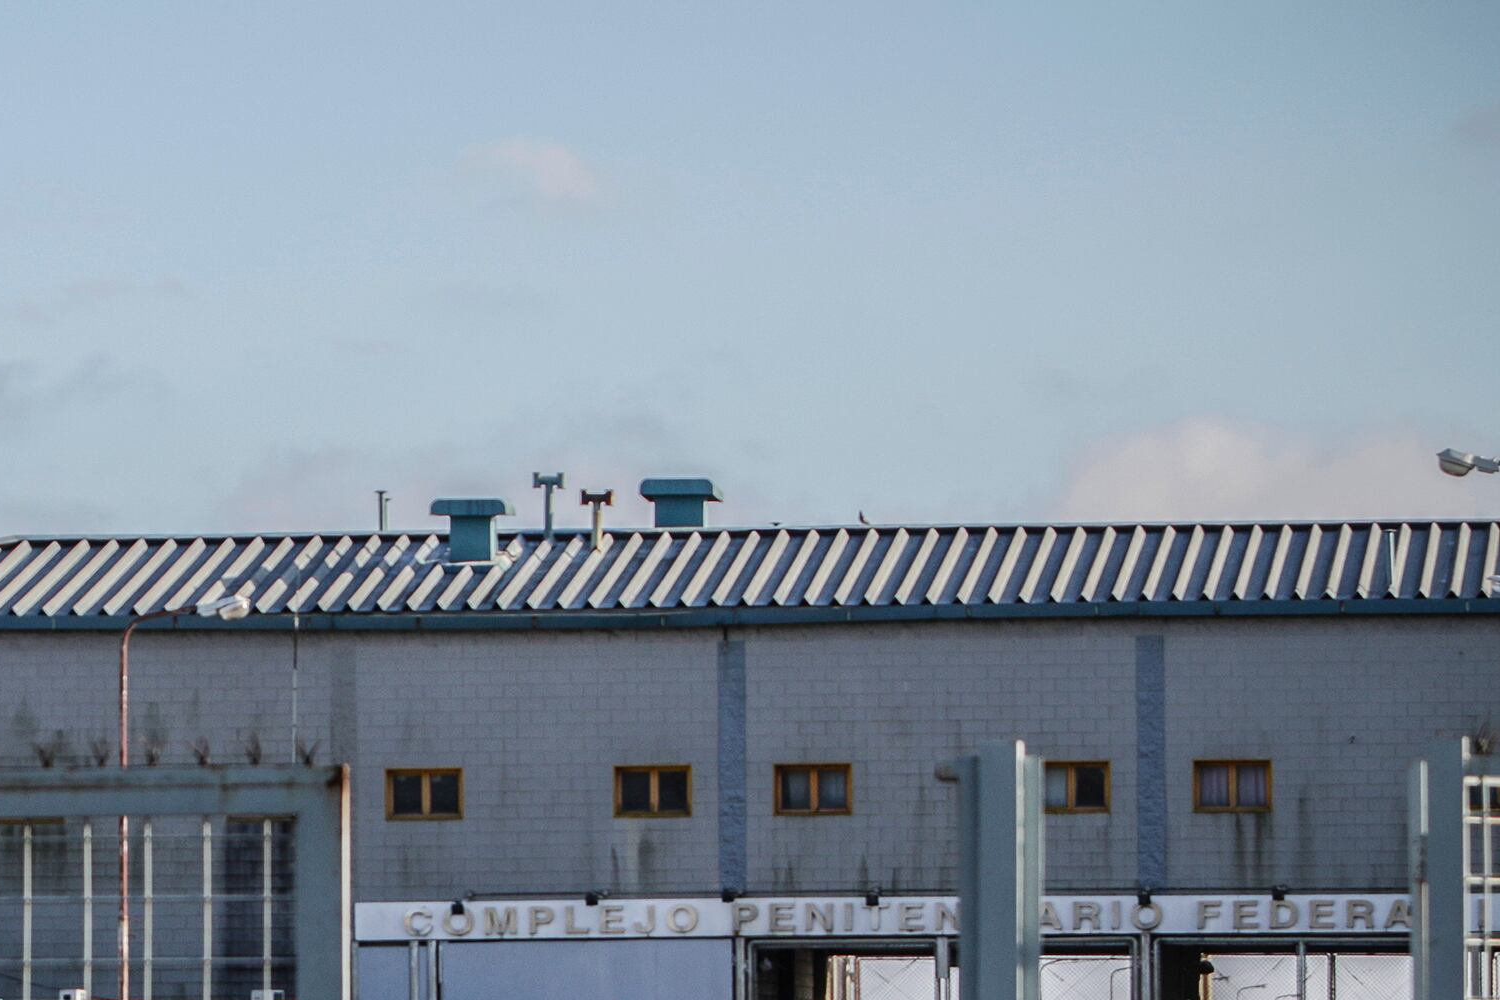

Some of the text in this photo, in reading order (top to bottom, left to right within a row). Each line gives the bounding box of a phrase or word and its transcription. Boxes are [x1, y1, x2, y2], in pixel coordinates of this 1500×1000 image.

[404, 903, 698, 937] COMPLEJO
[732, 900, 1162, 933] PENITENARIO
[1197, 899, 1414, 931] FEDERA
